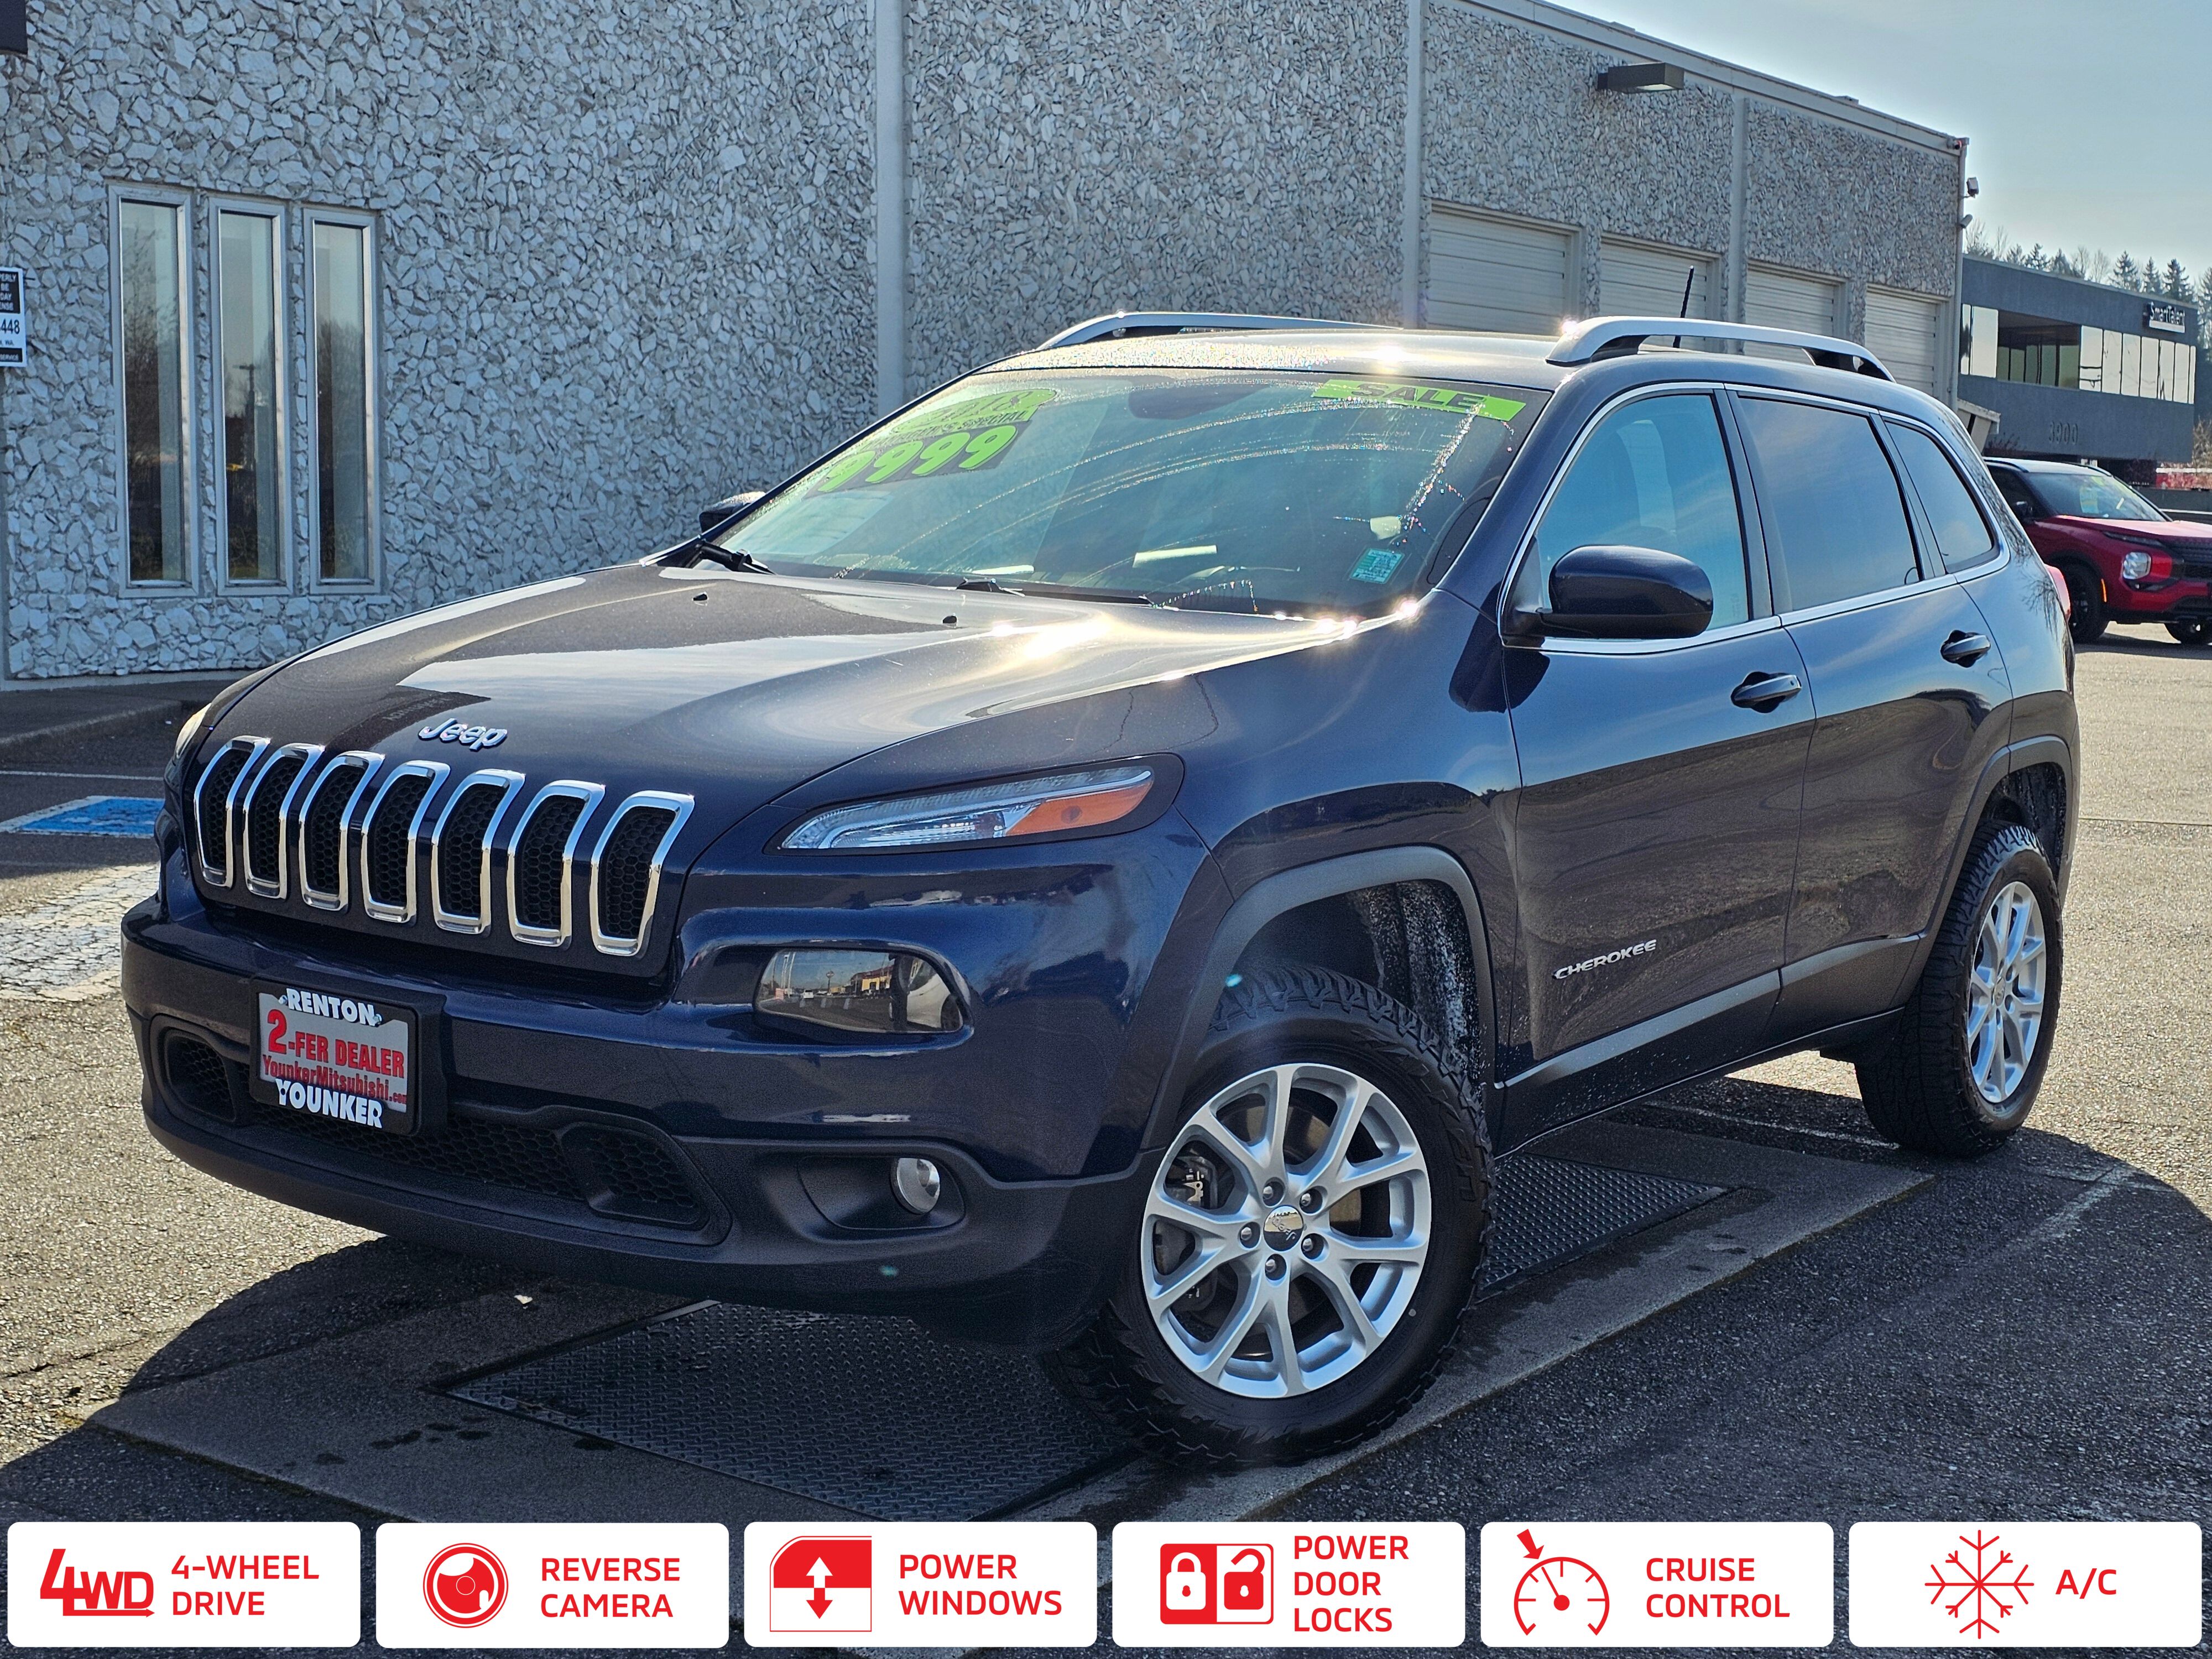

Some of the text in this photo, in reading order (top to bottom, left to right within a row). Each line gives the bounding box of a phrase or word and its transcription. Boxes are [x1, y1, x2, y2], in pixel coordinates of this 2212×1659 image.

[2150, 301, 2185, 326] SmartTalent
[1352, 383, 1486, 409] SALE
[956, 410, 1028, 430] SPECIAL
[817, 425, 1018, 493] 9999
[418, 718, 508, 751] Jeep
[1553, 939, 1657, 979] CHEROKEE
[286, 988, 376, 1027] RENTON
[267, 1008, 405, 1078] 2-FER DEALER
[275, 1078, 383, 1129] YOUNKER
